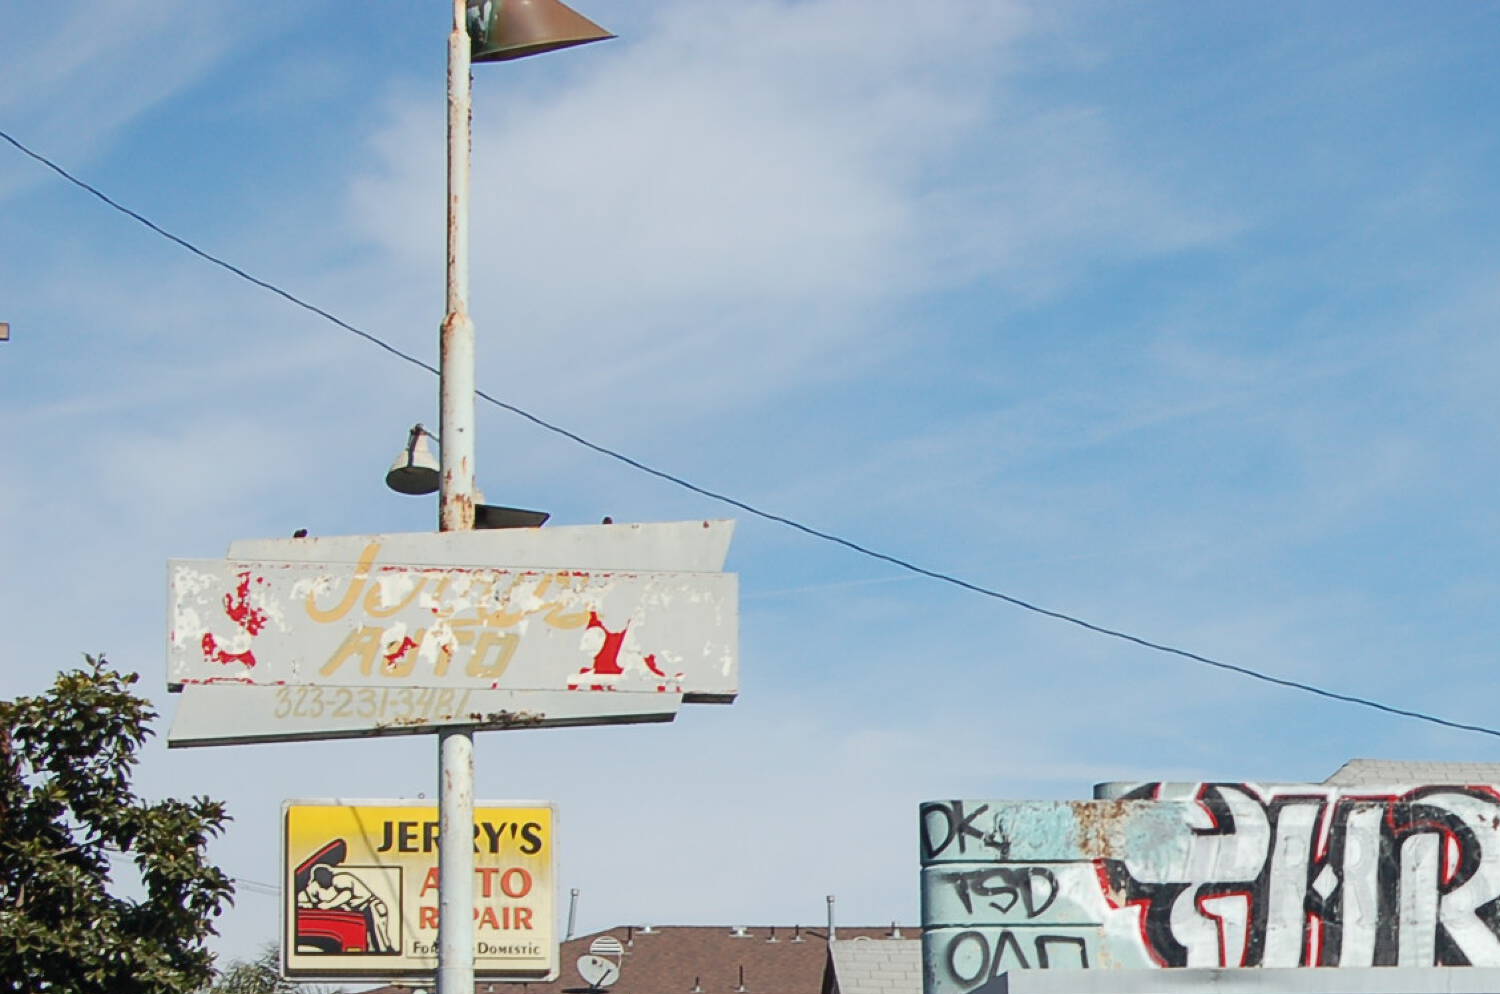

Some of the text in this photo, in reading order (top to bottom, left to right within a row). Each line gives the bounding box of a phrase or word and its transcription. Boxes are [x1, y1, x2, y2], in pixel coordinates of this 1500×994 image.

[319, 625, 520, 678] AUTO
[377, 820, 542, 855] JERY'S
[420, 867, 532, 899] ATO
[419, 906, 532, 930] RAIR
